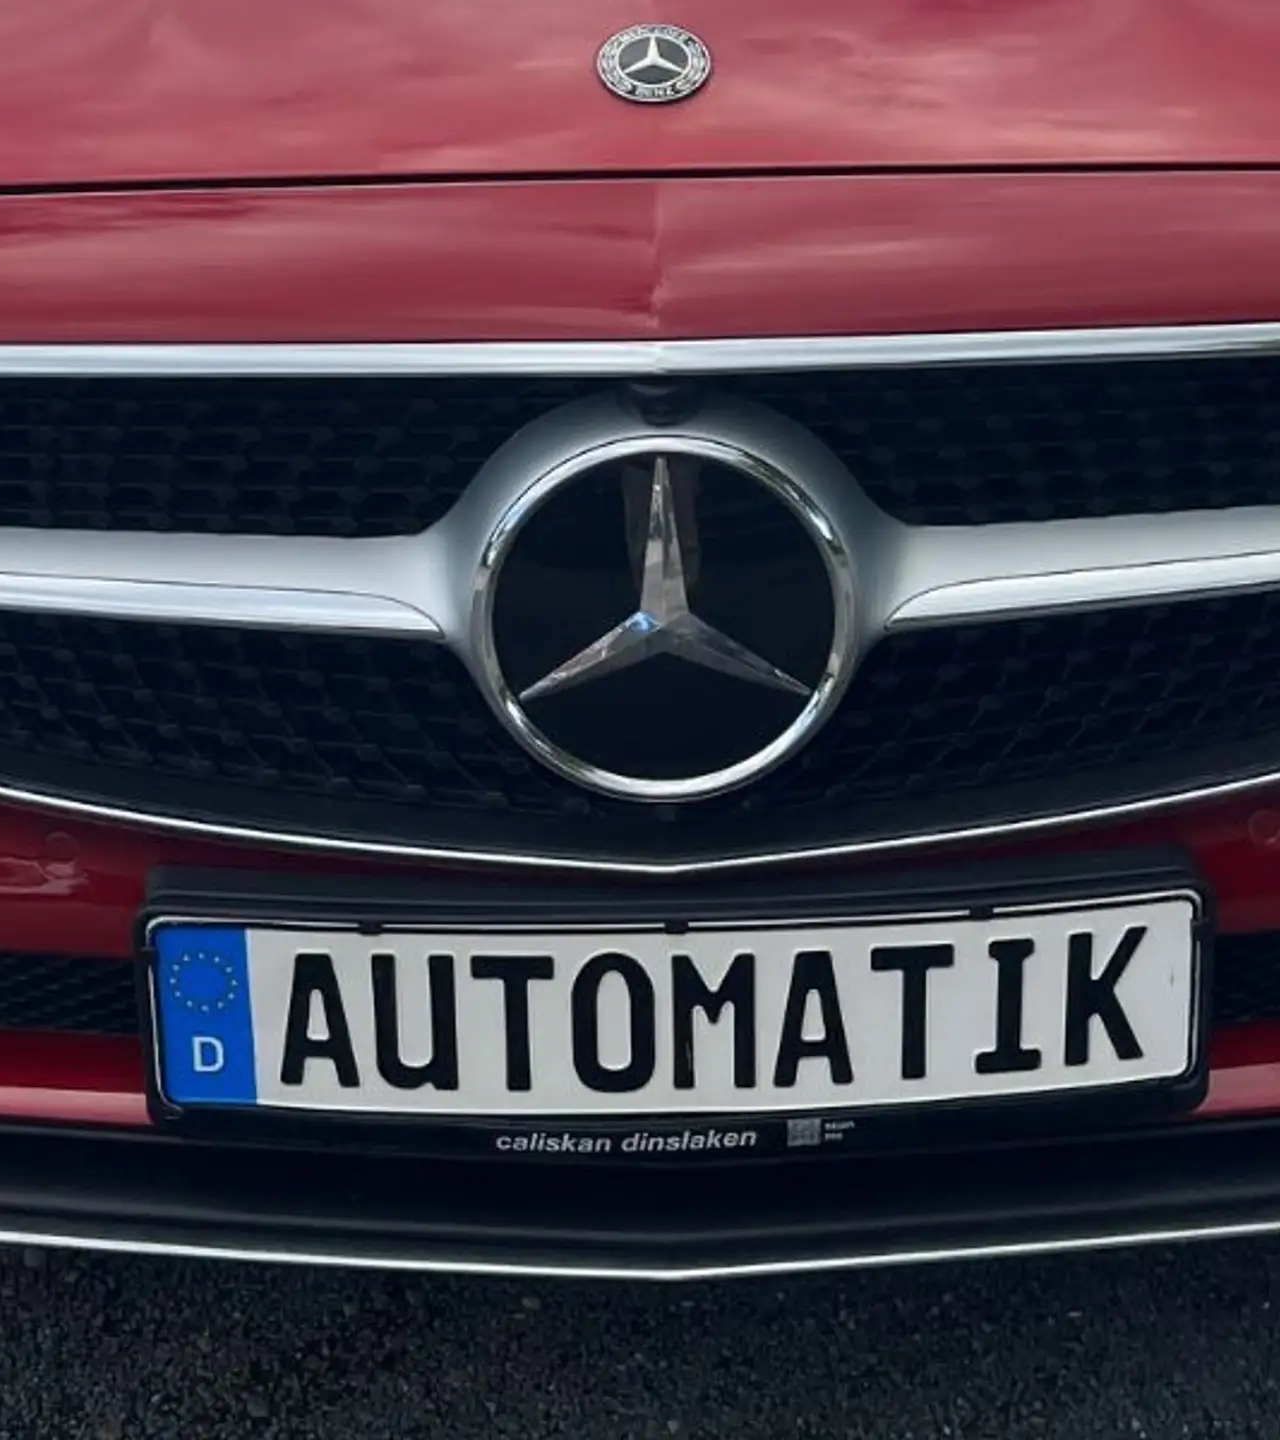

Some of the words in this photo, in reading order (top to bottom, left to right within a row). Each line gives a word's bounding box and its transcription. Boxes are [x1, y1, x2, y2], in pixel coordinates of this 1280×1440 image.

[279, 925, 1148, 1093] AUTOMATIK
[191, 1035, 225, 1073] D
[495, 1132, 612, 1153] caliskan
[620, 1129, 757, 1153] dinslaken
